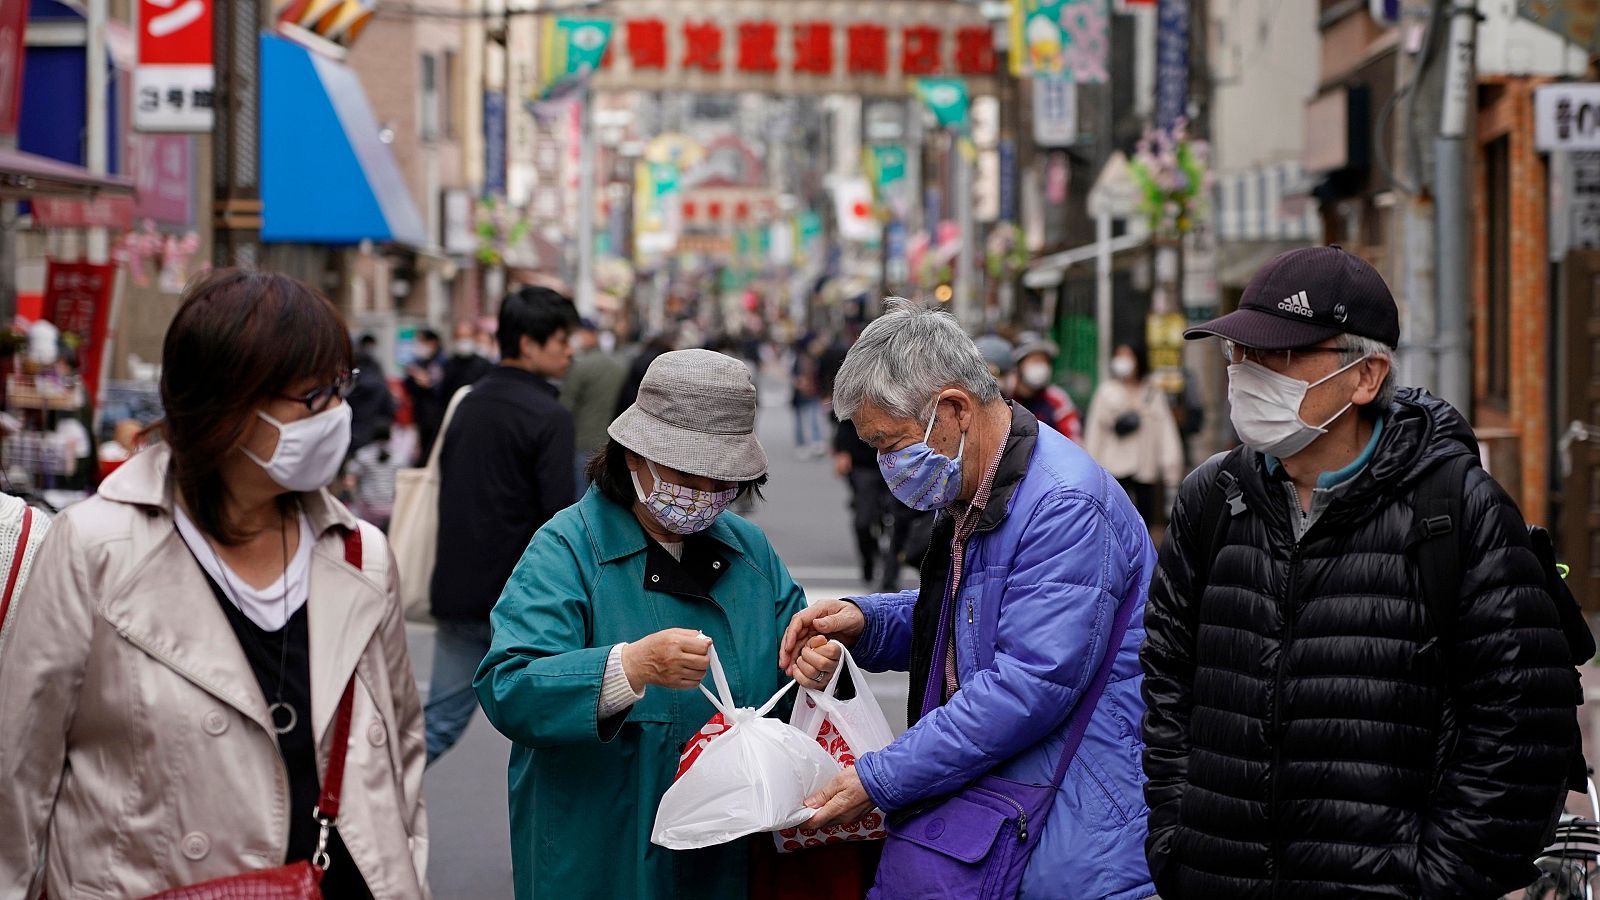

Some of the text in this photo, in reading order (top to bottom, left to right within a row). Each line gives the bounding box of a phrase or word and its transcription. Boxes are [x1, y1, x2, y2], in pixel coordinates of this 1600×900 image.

[603, 17, 996, 75] 鴨地蔵通商店街
[1277, 301, 1314, 318] adidas
